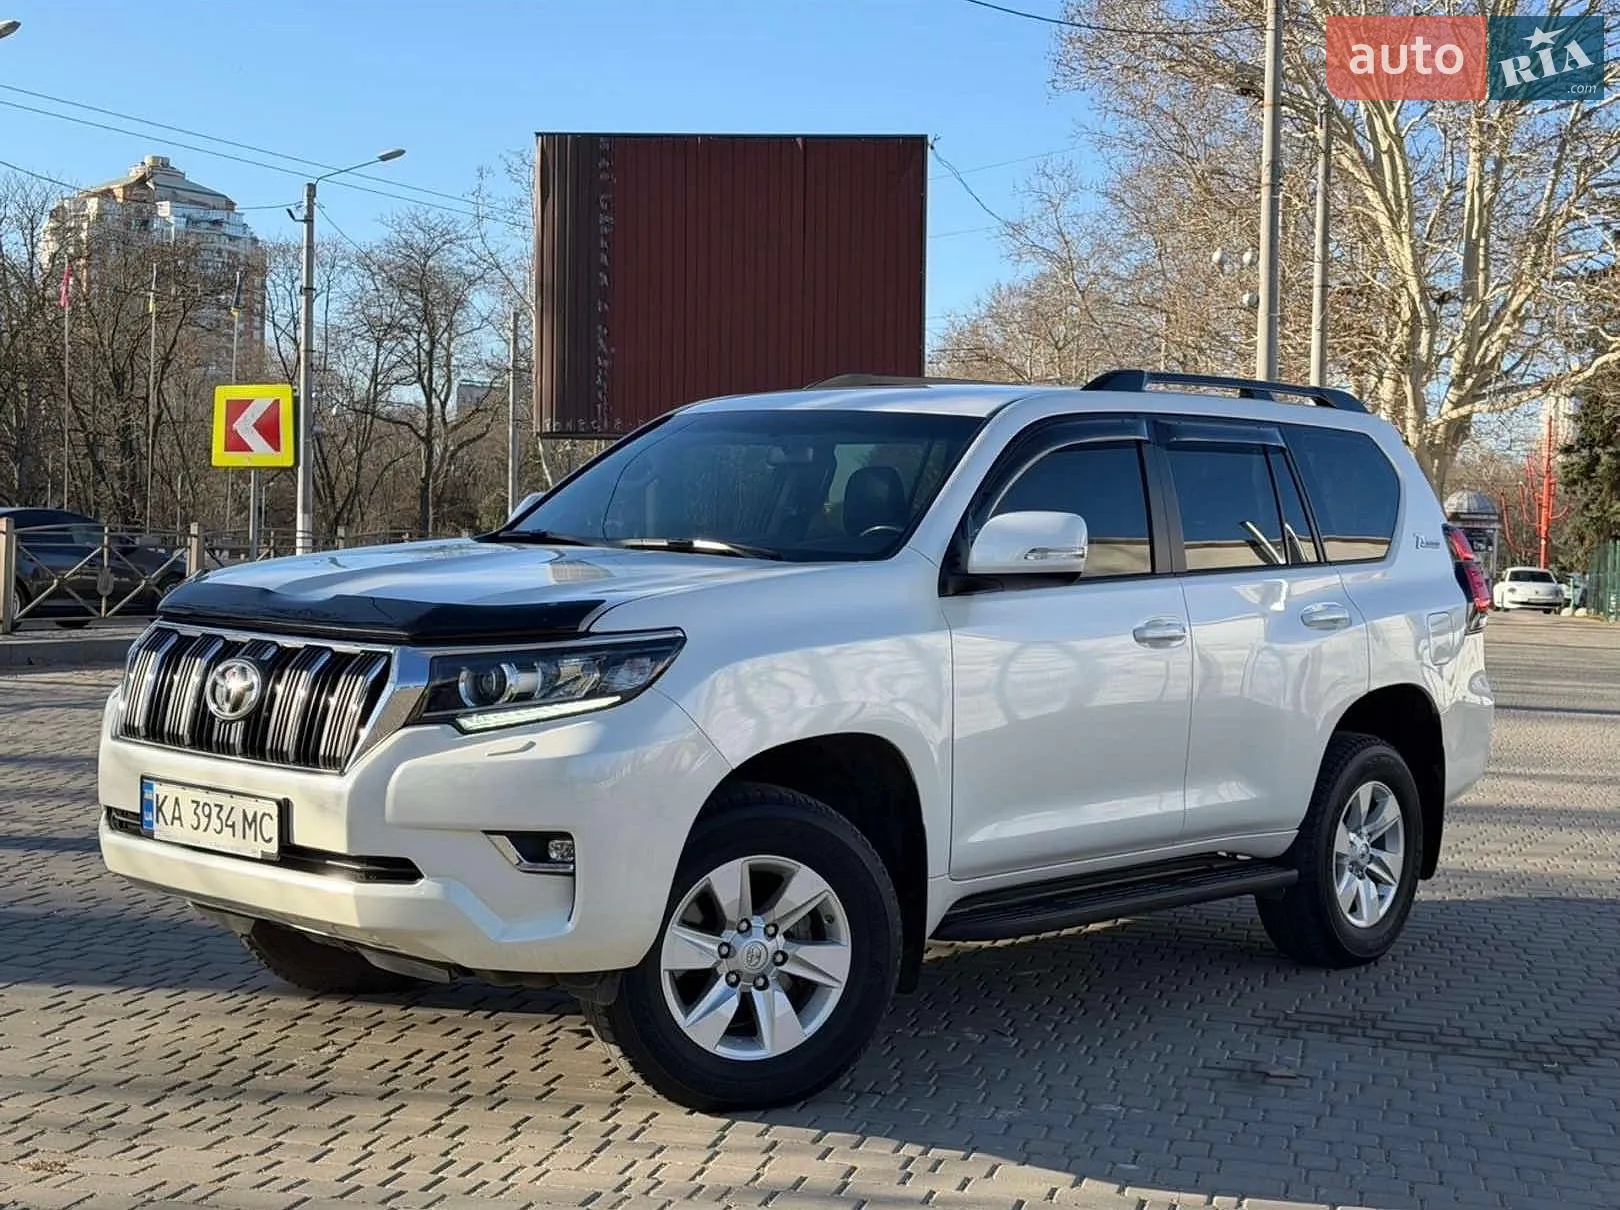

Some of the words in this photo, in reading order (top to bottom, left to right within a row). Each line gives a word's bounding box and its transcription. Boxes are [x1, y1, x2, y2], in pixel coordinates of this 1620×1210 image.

[155, 793, 184, 828] KA
[190, 799, 236, 838] 3934
[242, 808, 274, 844] MC
